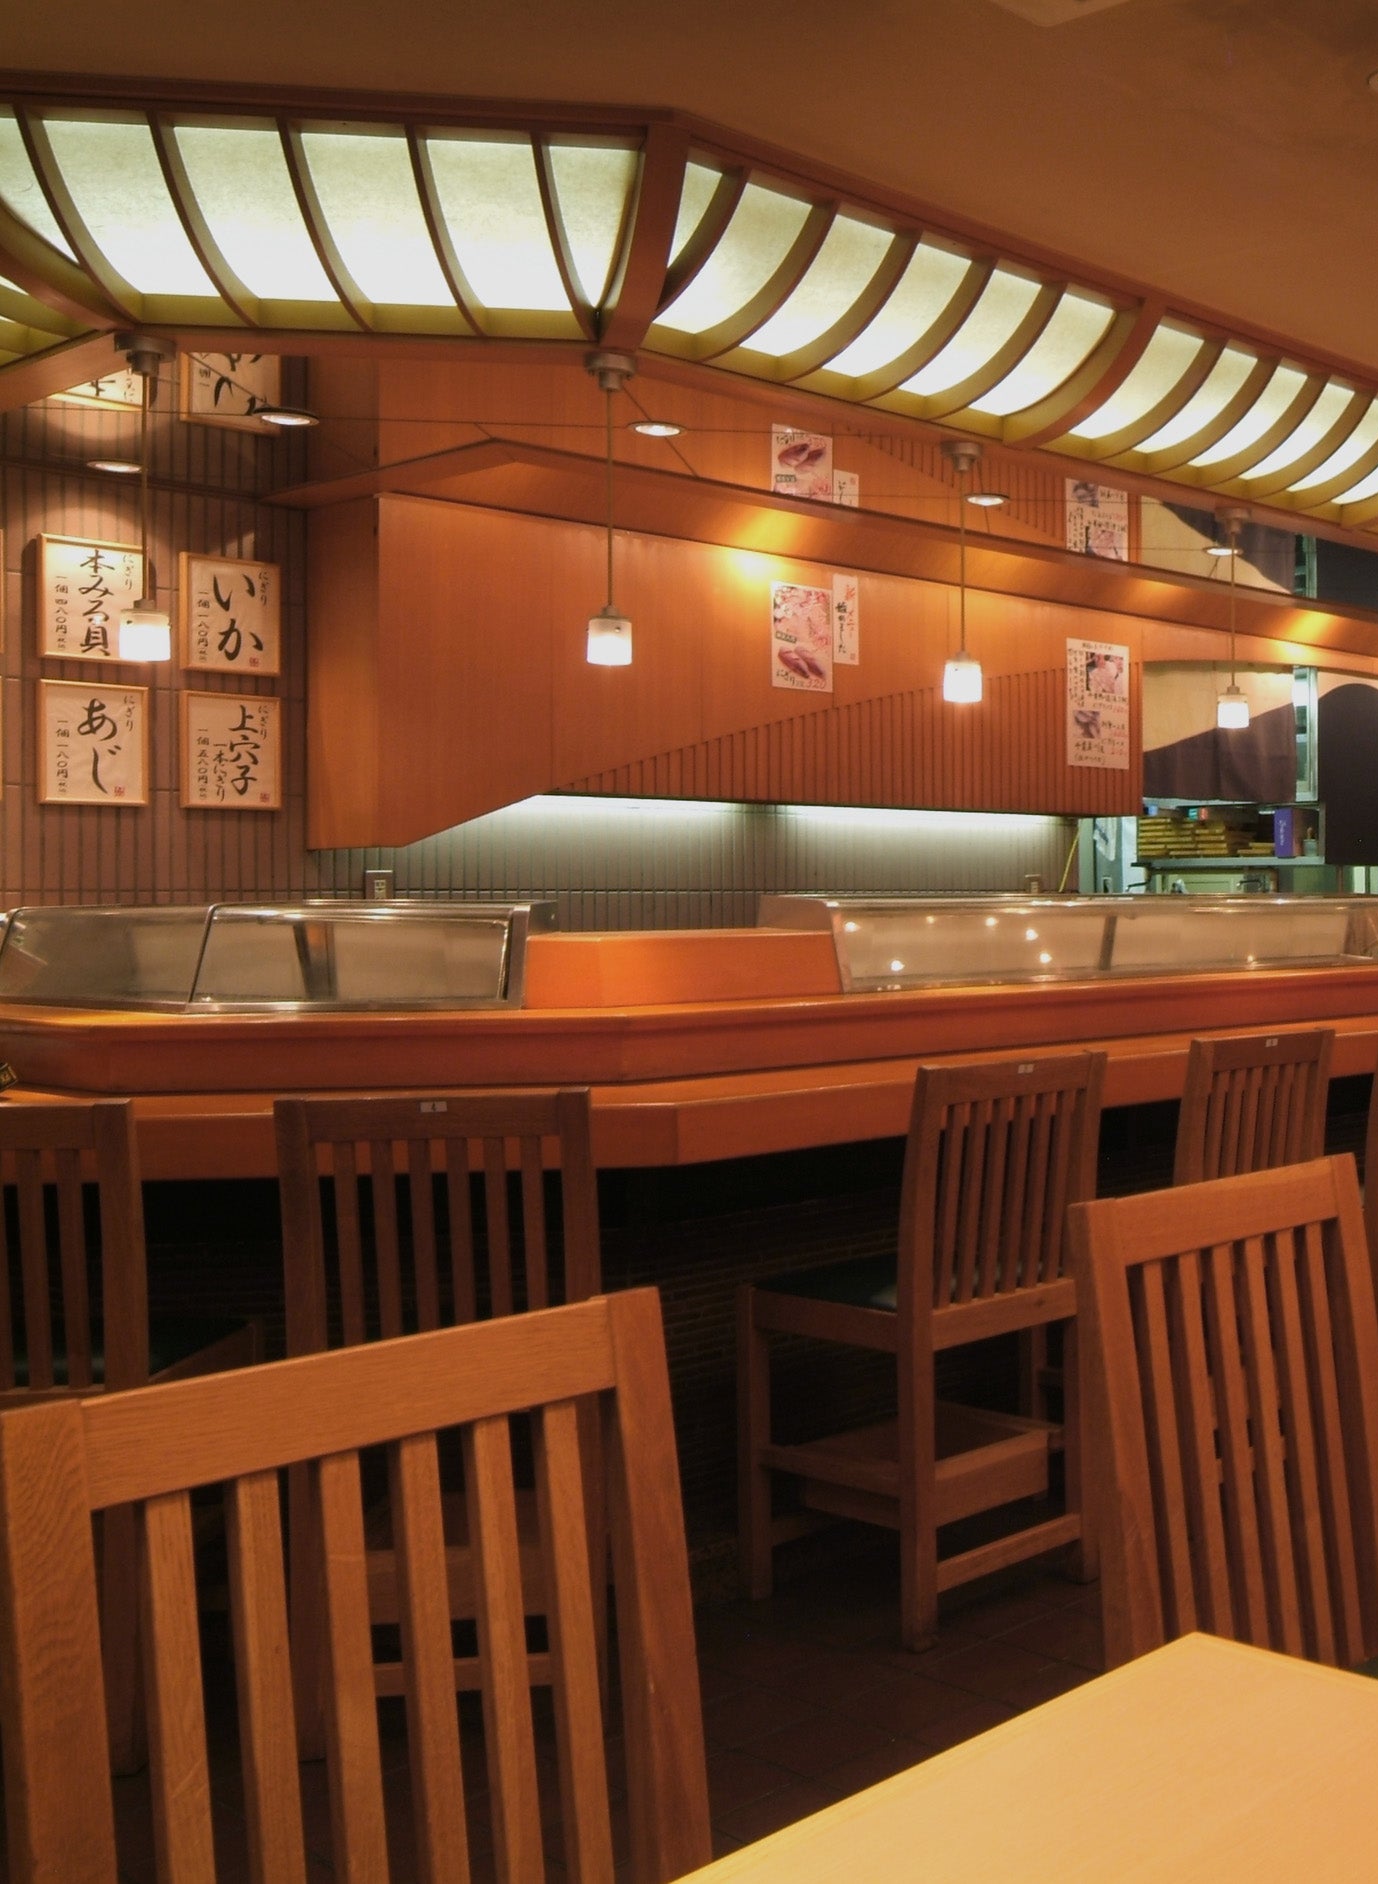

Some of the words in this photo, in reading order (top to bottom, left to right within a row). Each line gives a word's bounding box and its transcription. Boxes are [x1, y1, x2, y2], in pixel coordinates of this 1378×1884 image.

[78, 549, 115, 657] 本みる貝
[212, 573, 264, 661] いか
[77, 698, 122, 795] あじ
[228, 704, 261, 796] 上穴子
